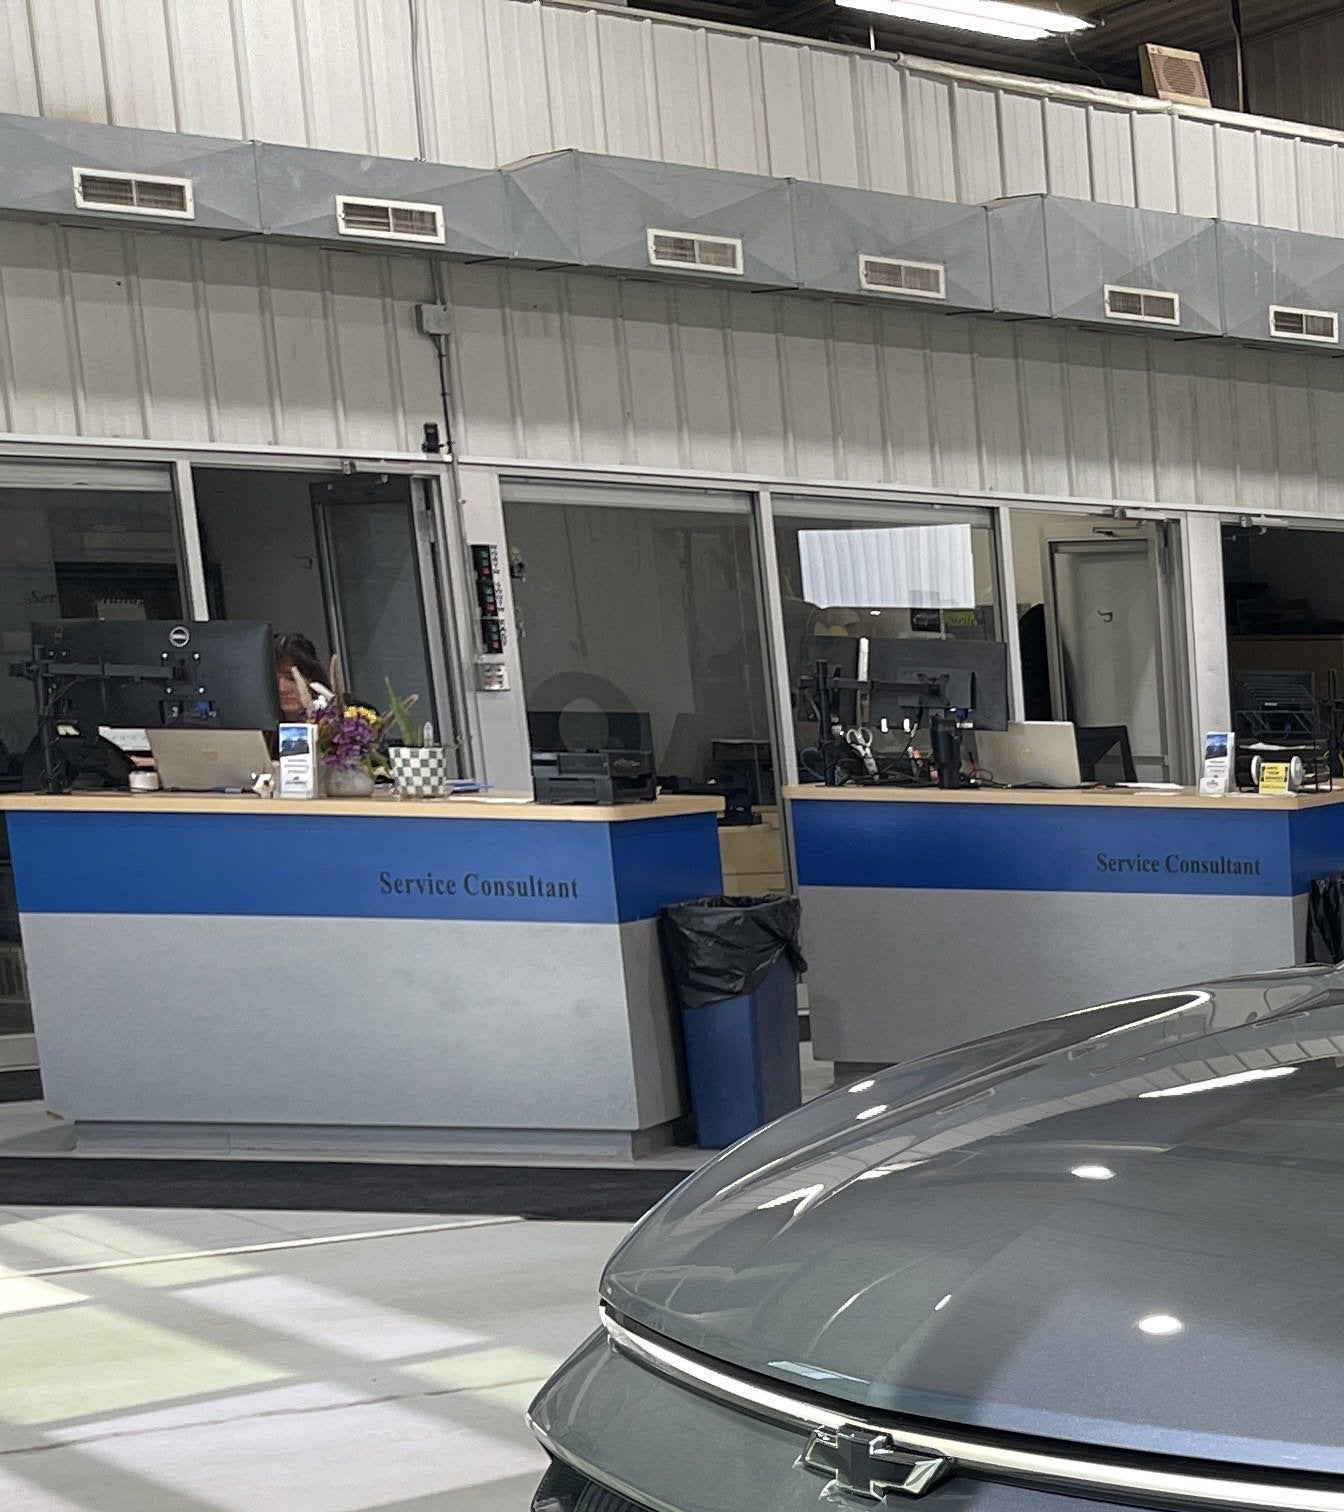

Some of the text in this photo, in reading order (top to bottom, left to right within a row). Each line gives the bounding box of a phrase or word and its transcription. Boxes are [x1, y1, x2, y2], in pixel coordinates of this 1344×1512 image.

[1096, 852, 1262, 876] Service Consultant
[379, 870, 579, 899] Service Consultant
